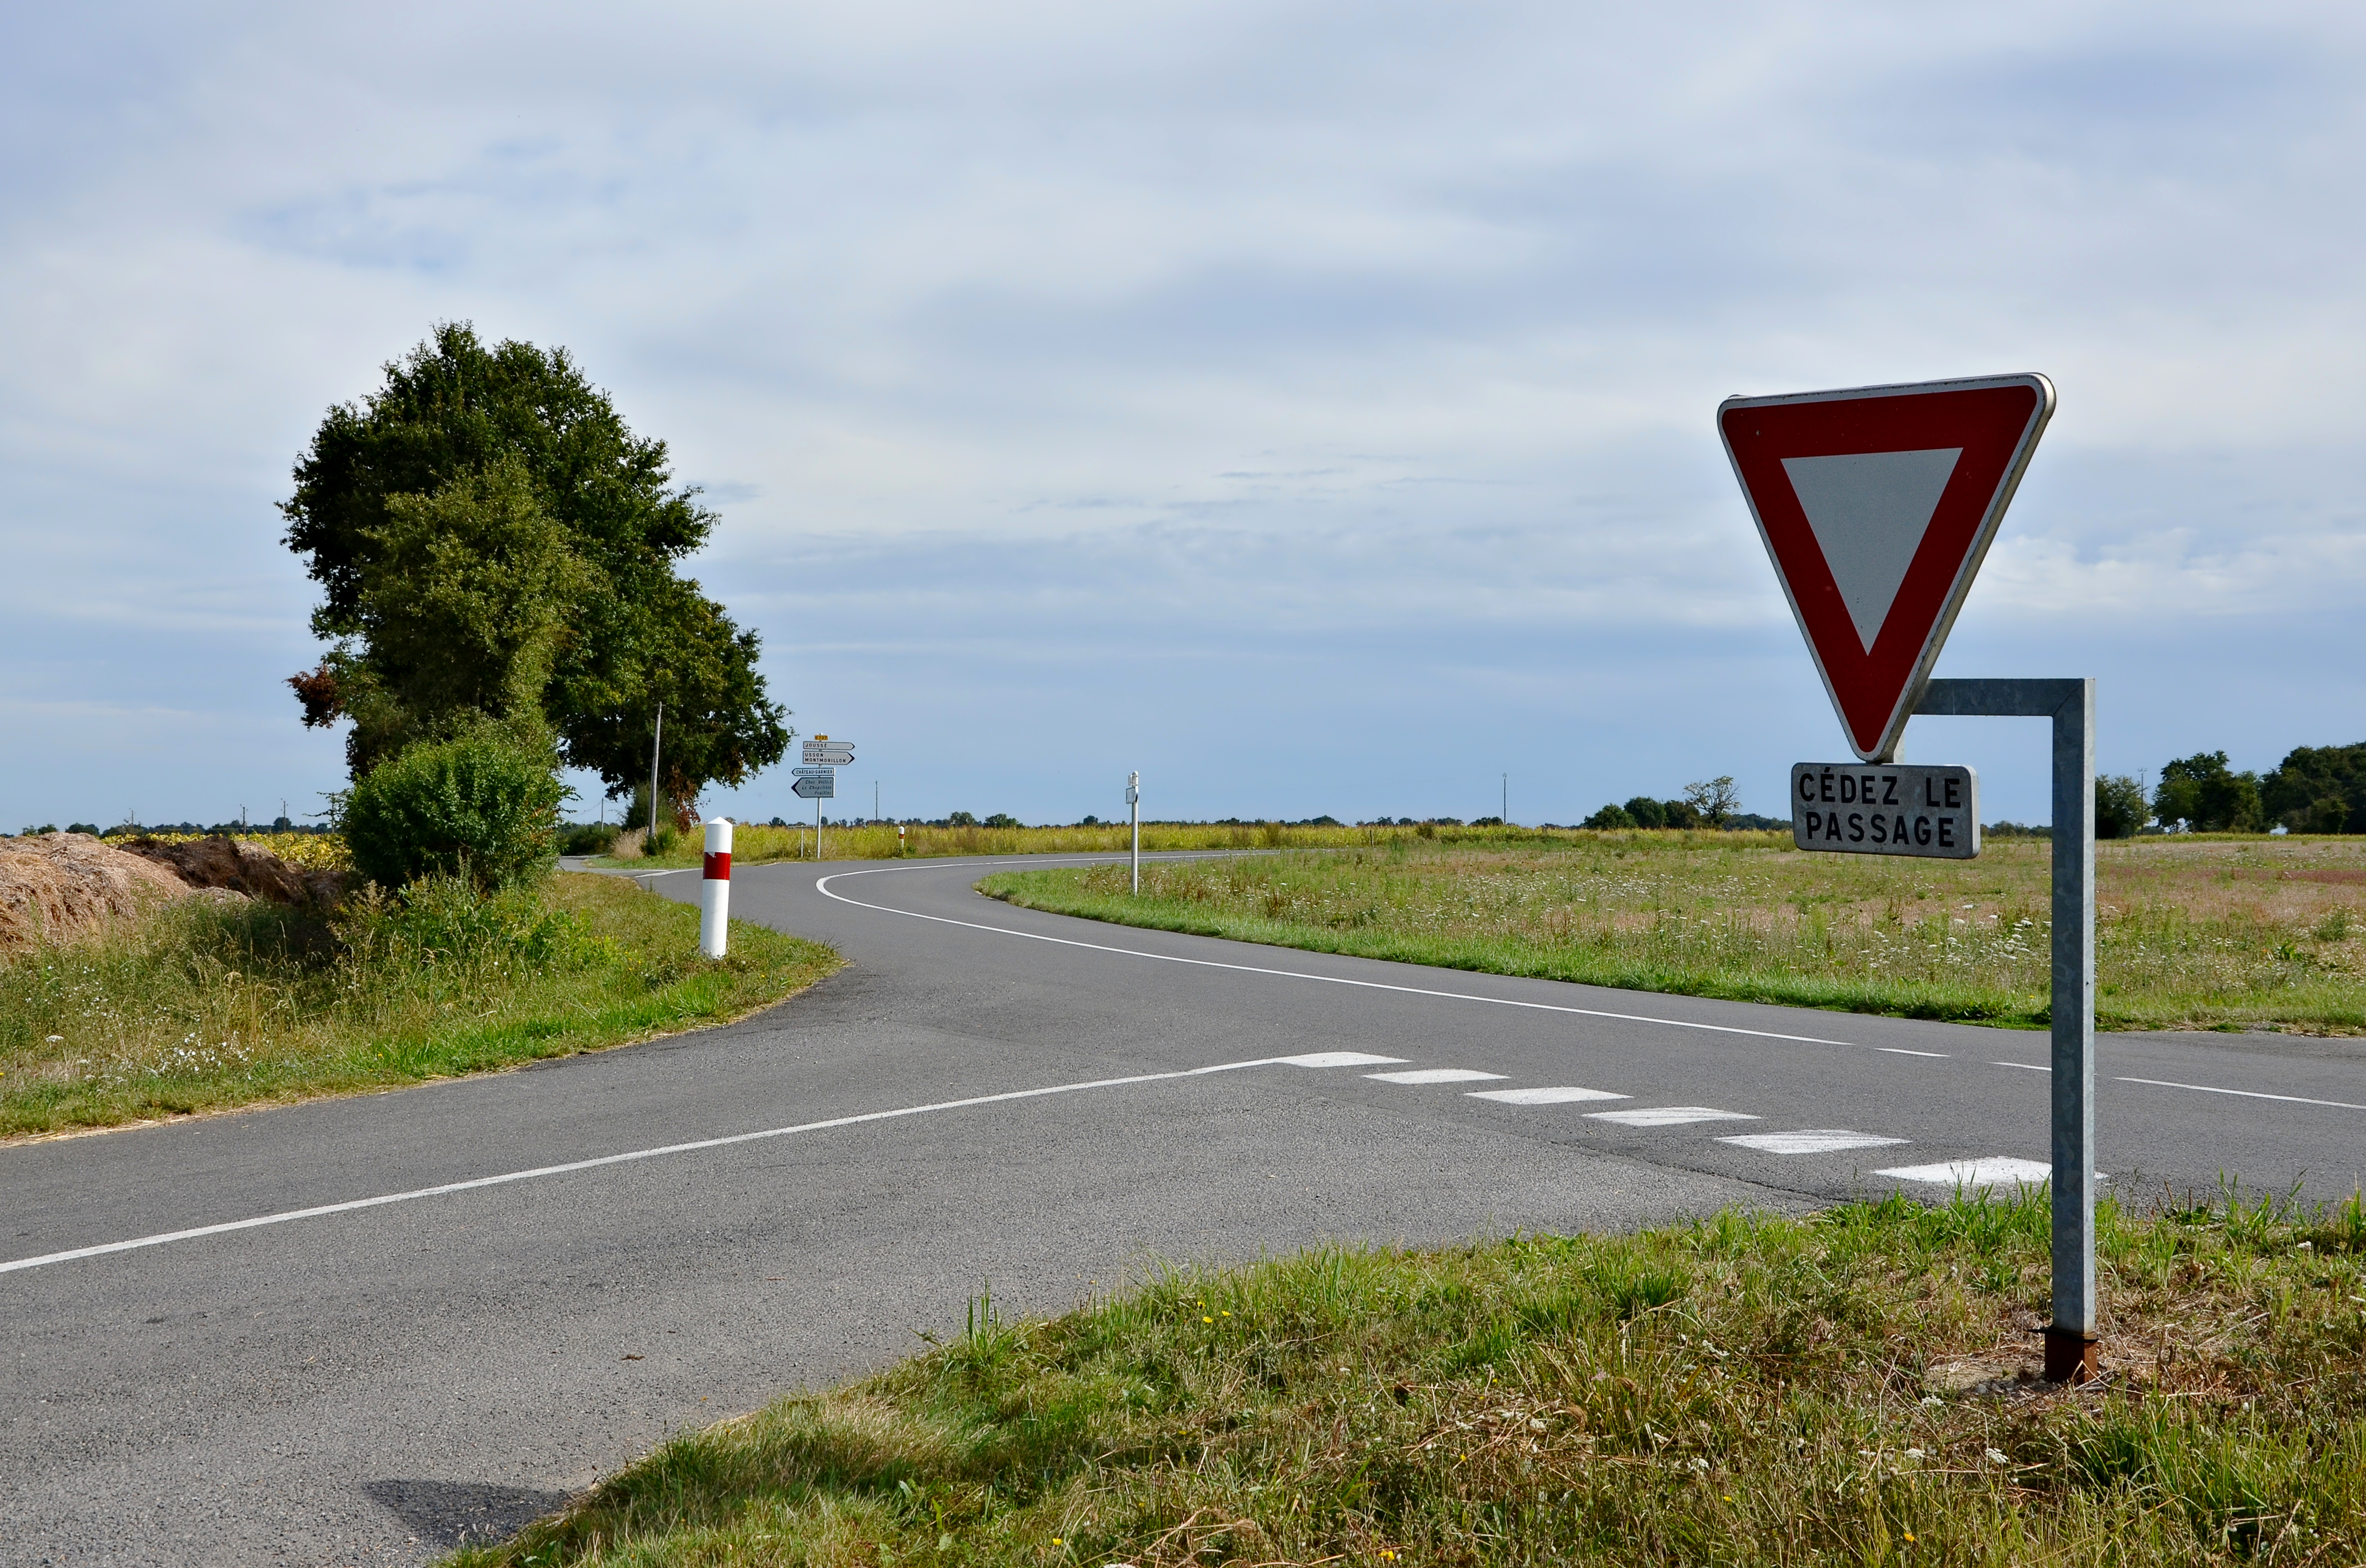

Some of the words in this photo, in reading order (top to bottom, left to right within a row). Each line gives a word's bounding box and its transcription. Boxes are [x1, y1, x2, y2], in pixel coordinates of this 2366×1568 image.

[1799, 767, 1899, 805] CÉDEZ
[1926, 777, 1961, 808] LE
[1806, 811, 1954, 847] PASSAGE
